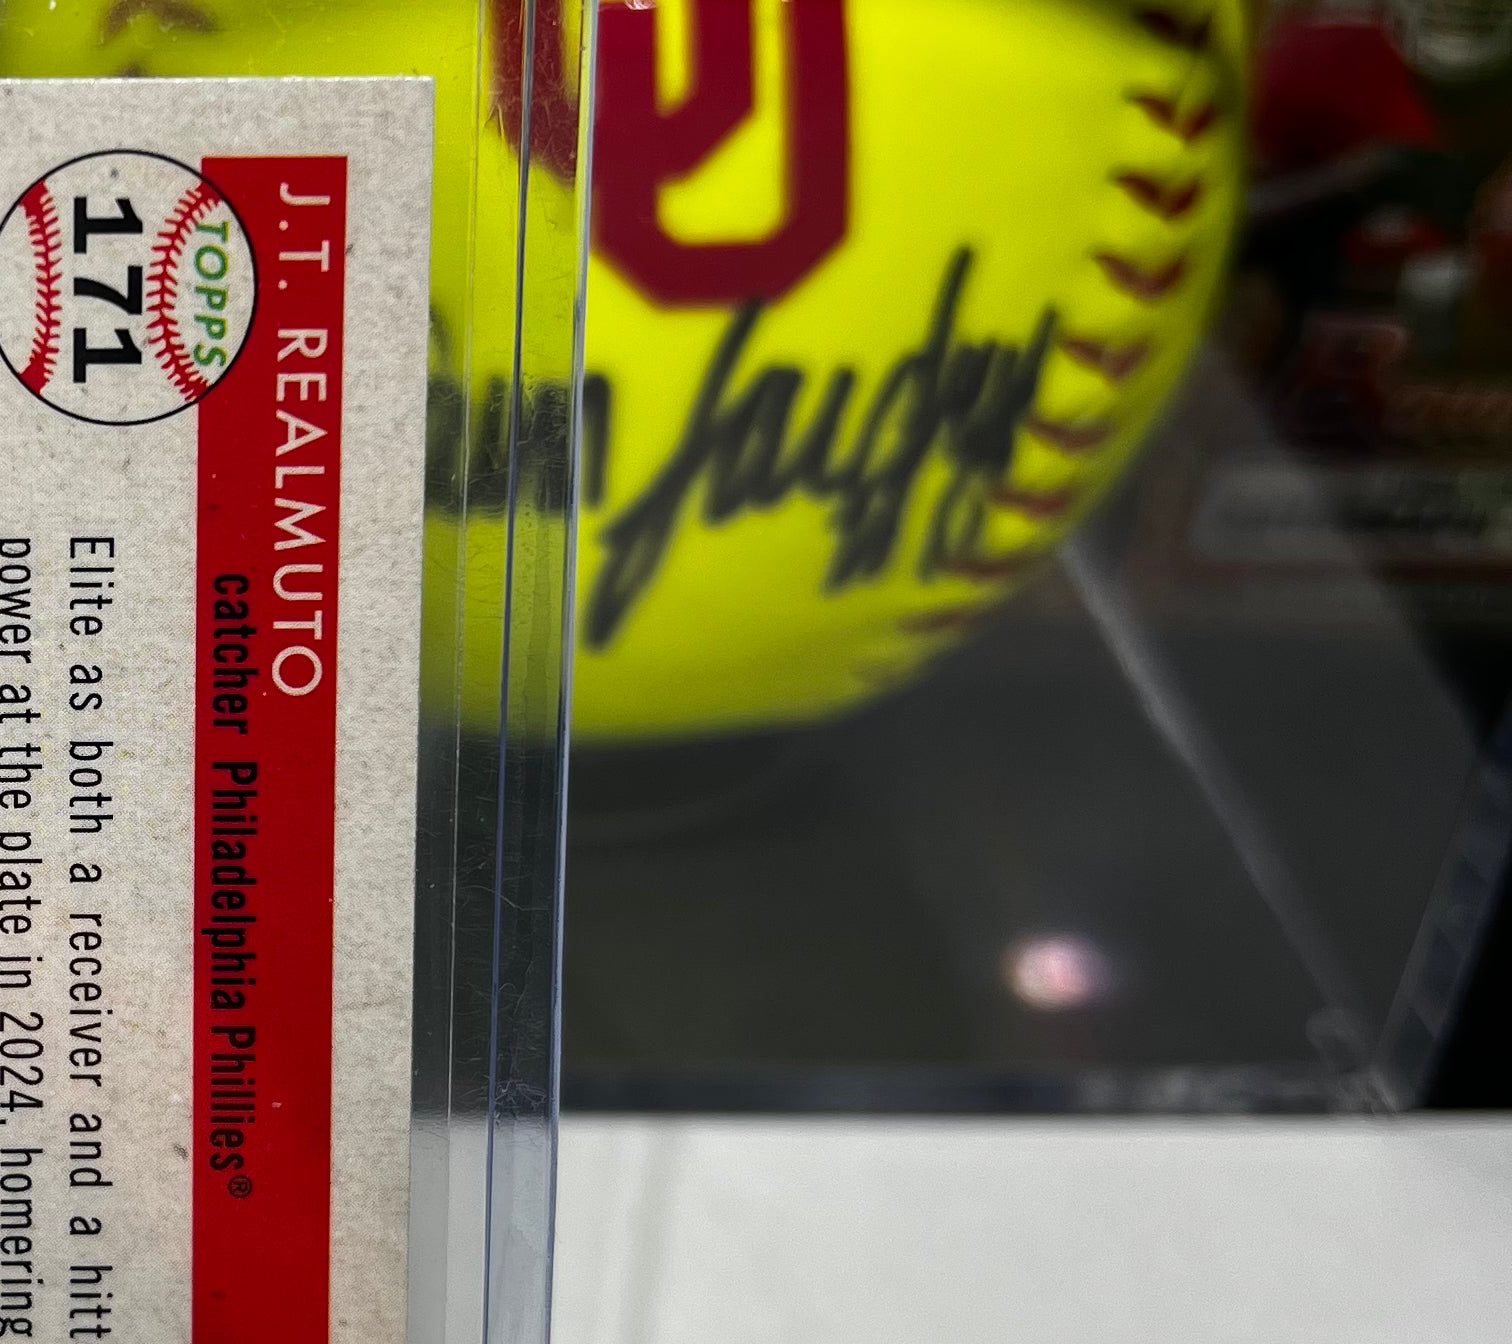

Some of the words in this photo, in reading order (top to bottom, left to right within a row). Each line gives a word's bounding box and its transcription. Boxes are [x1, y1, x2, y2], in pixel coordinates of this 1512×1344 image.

[70, 195, 145, 385] 171
[277, 182, 331, 290] J.T.
[190, 219, 231, 369] TOPPS
[270, 328, 328, 697] REALMUTO
[68, 537, 115, 637] Elite
[67, 664, 103, 711] as
[211, 574, 260, 735] catcher
[67, 740, 114, 834] both
[68, 862, 103, 884] a
[201, 761, 259, 1010] Philadelphia
[67, 913, 114, 1088] receiver
[68, 1113, 114, 1187] and
[68, 1215, 102, 1236] a
